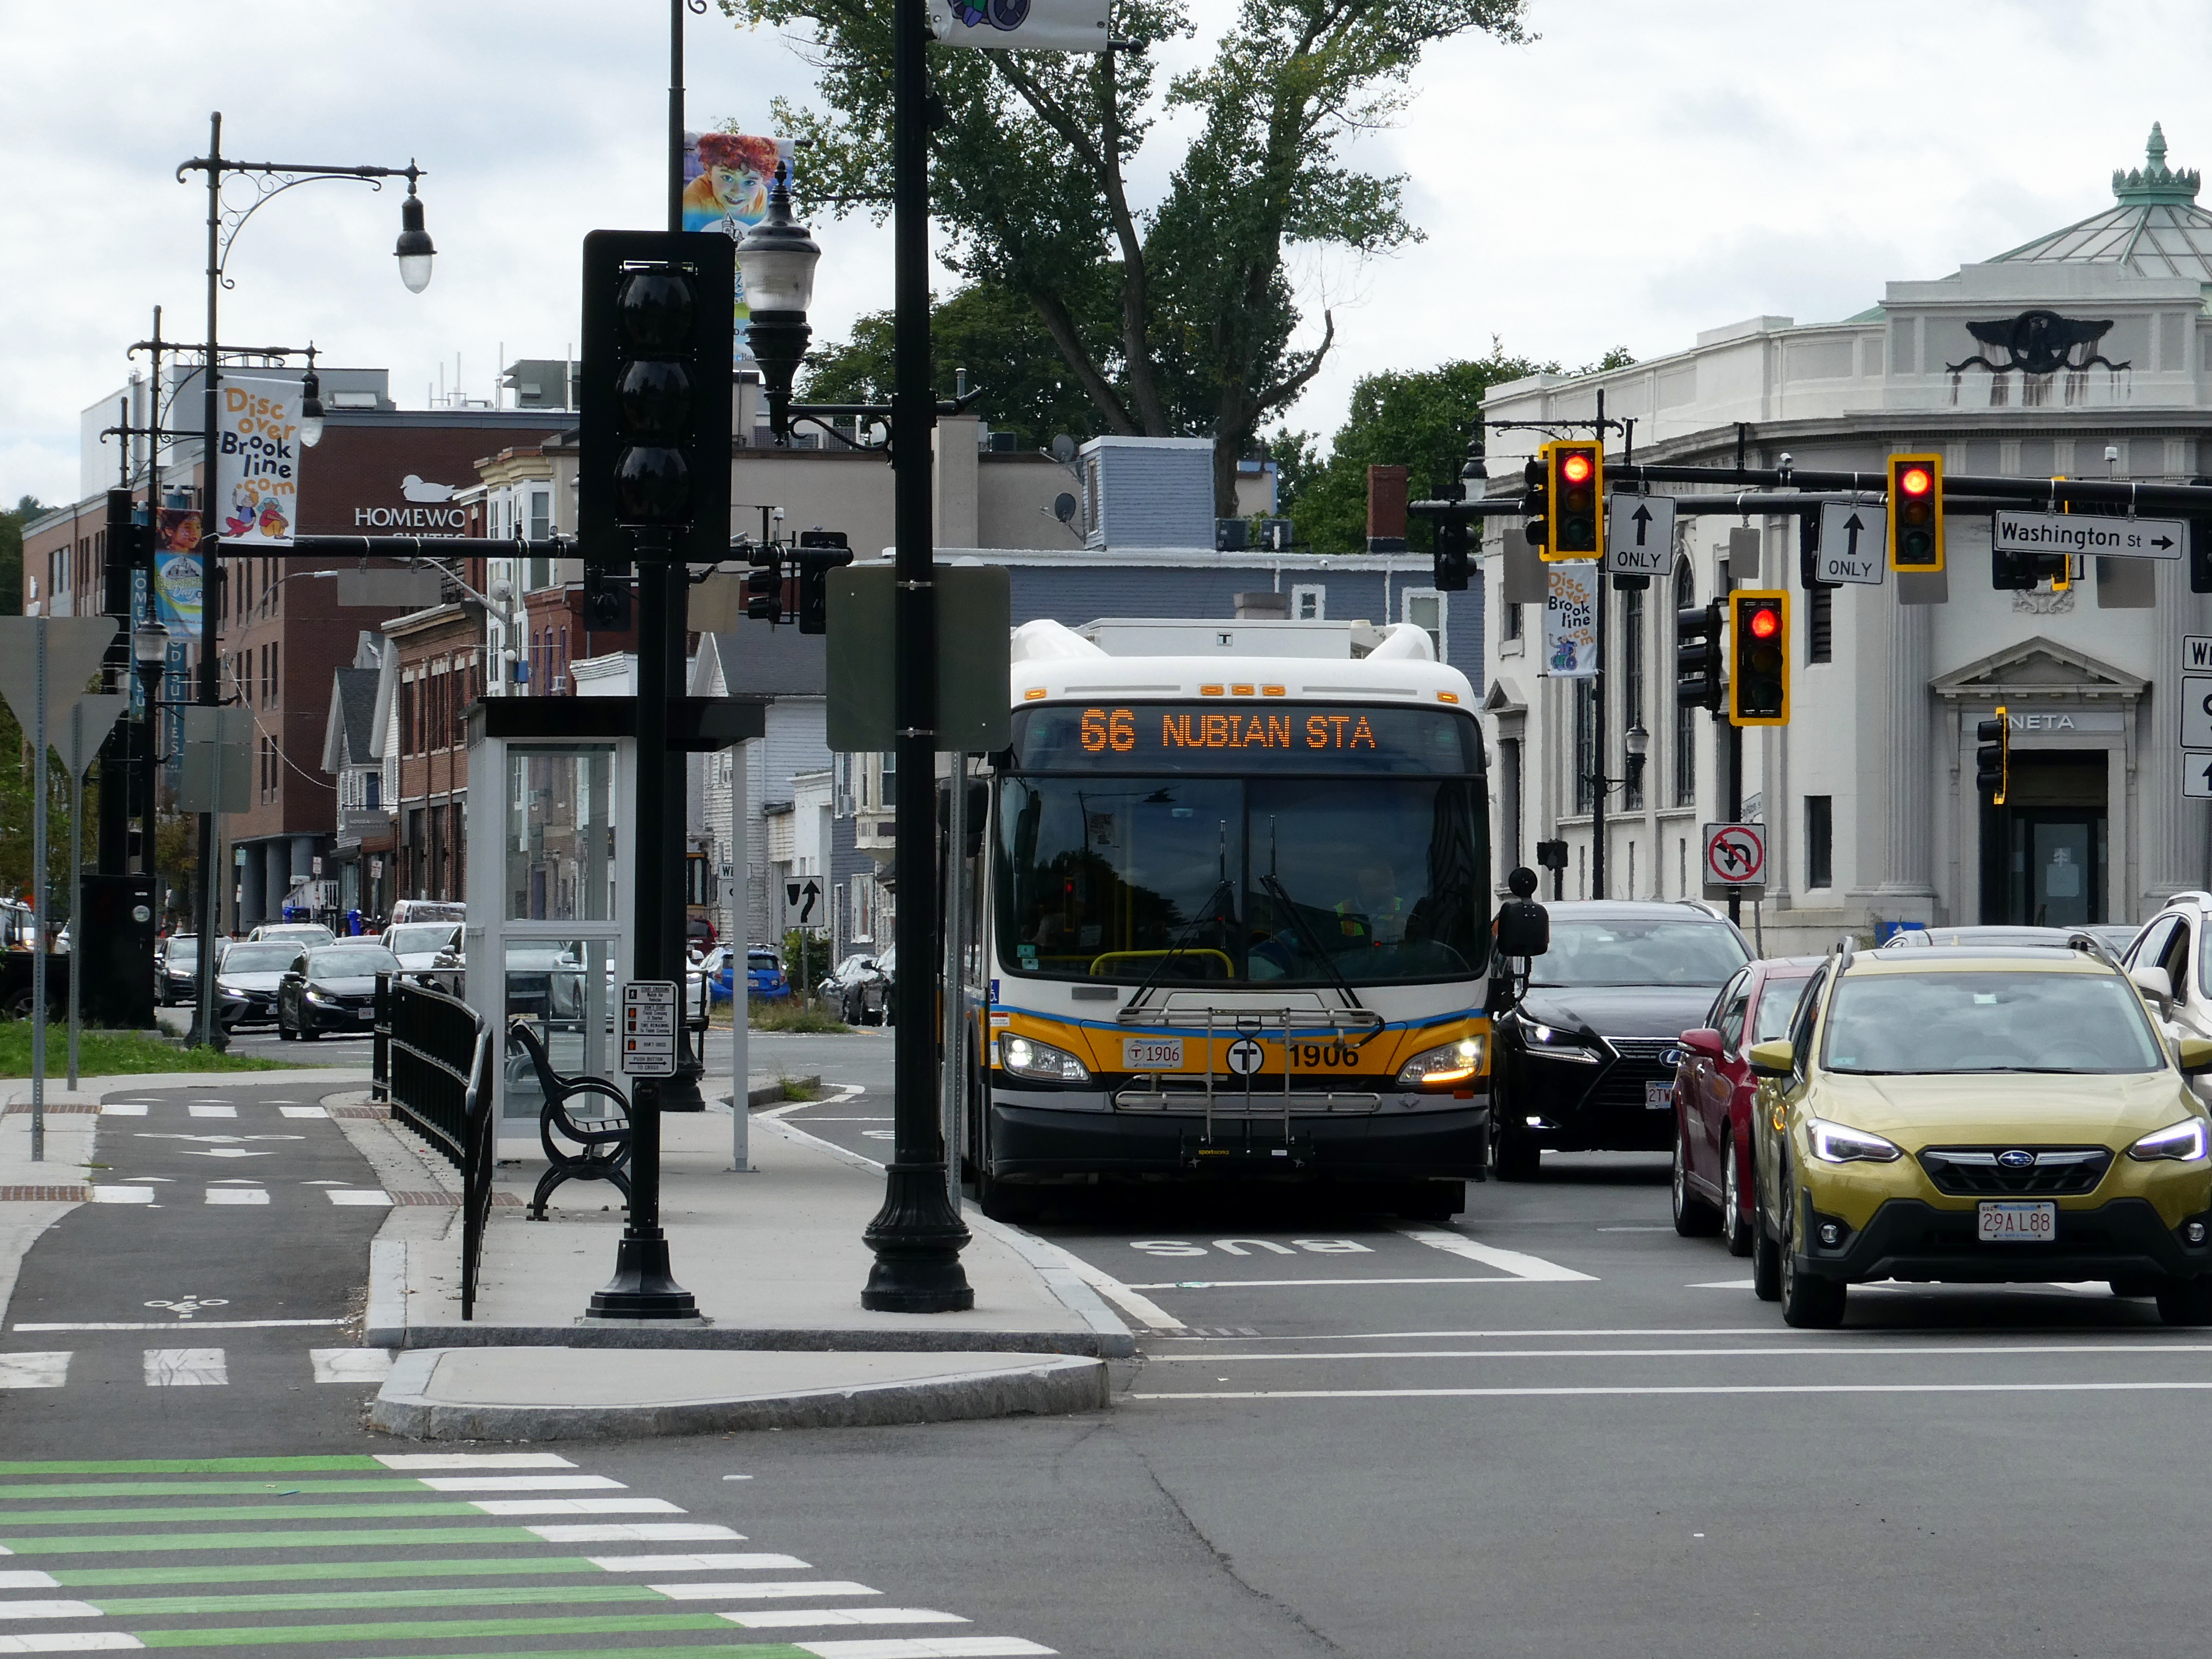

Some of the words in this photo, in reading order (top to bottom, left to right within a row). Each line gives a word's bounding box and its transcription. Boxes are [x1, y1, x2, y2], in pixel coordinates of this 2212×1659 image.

[227, 387, 284, 420] Disc
[238, 417, 296, 441] over
[221, 431, 292, 459] Brook
[243, 453, 291, 479] line
[236, 478, 295, 496] .com
[2002, 522, 2120, 550] Washington
[2128, 534, 2142, 547] St
[1618, 551, 1661, 568] ONLY
[1829, 560, 1872, 577] ONLY
[1549, 572, 1584, 593] Disc
[1554, 587, 1591, 605] over
[1548, 596, 1591, 616] Brook
[1562, 613, 1591, 629] line
[1218, 634, 1231, 644] T
[1081, 709, 1134, 751] 66
[1162, 714, 1290, 748] NUBIAN
[1306, 715, 1376, 748] STA
[2008, 714, 2074, 729] NETA
[1146, 1046, 1179, 1061] 1906
[1289, 1045, 1359, 1067] 1906
[1649, 1088, 1670, 1102] 2TW
[1129, 1239, 1376, 1257] BUS
